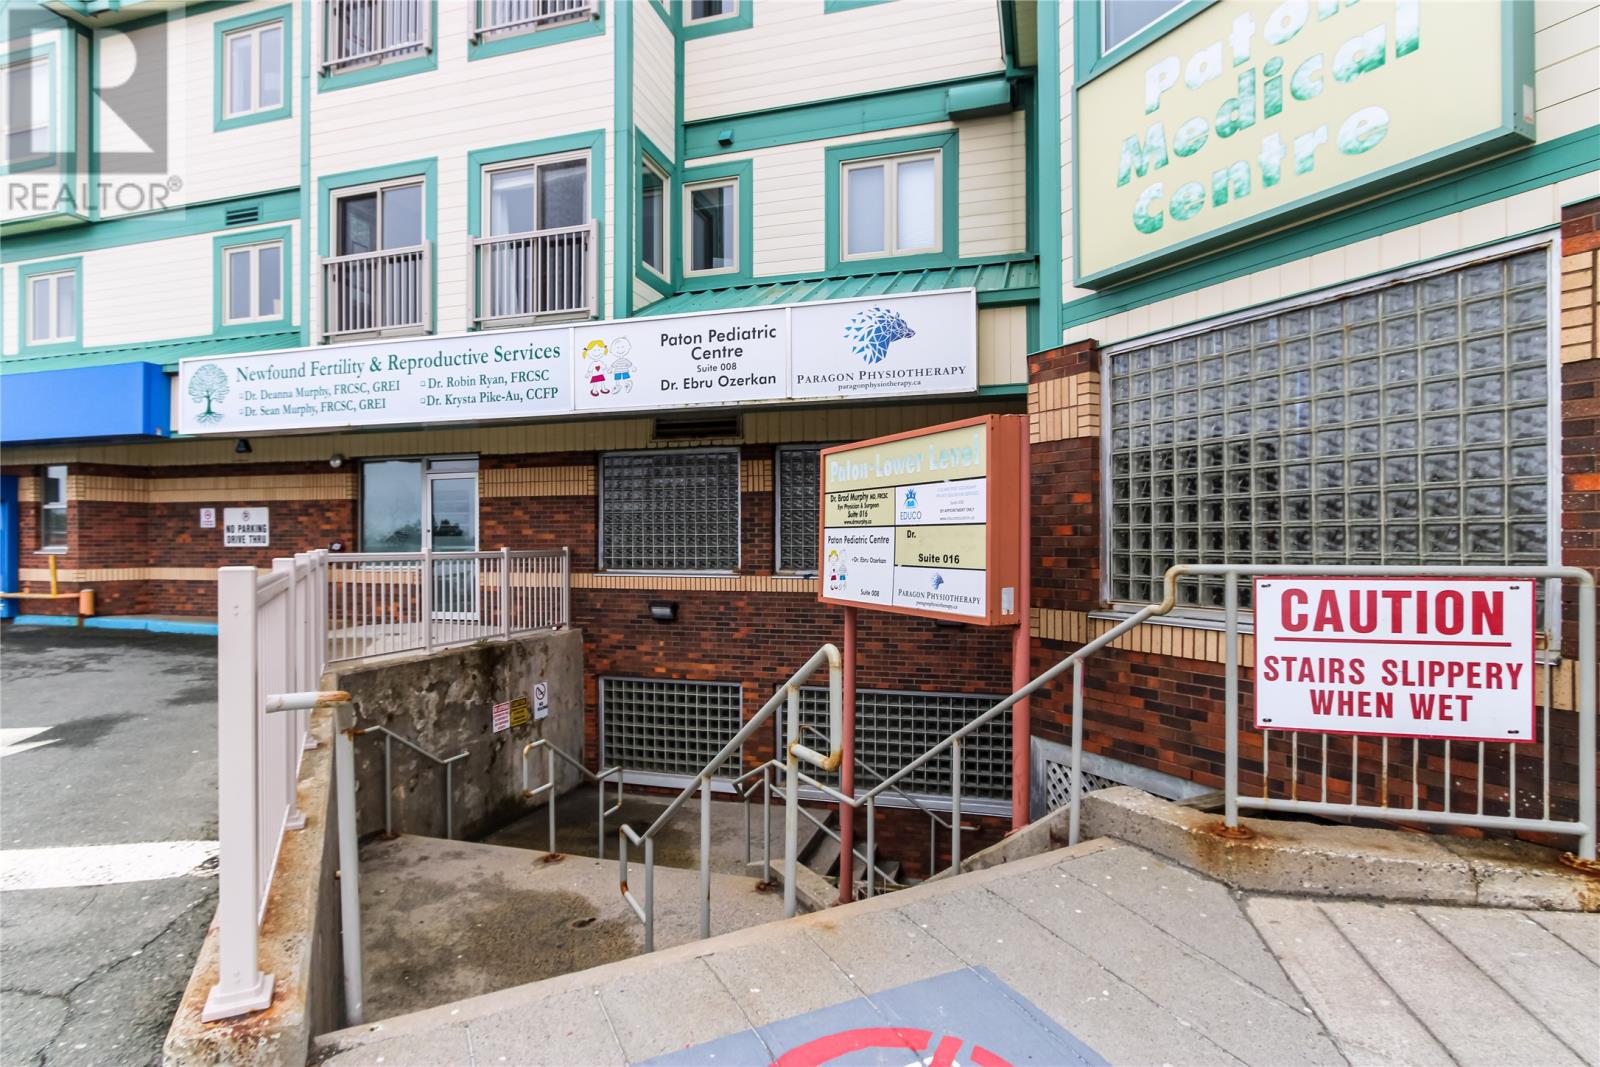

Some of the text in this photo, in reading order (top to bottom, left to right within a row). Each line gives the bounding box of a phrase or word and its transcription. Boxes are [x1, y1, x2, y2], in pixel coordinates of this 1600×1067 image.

[1117, 0, 1420, 188] Medical
[1133, 105, 1390, 234] Centre
[660, 324, 777, 347] Paton Pediatric
[236, 342, 561, 383] Newfound Fertility & Reproductive Services
[691, 346, 743, 361] Centre
[697, 362, 737, 373] Suite 008
[797, 366, 967, 385] PARAGON PHYSIOTHERAPY
[428, 369, 550, 389] Dr. Robin Ryan, FRCSC
[660, 373, 776, 391] Dr. Ebru Ozerkan
[838, 380, 922, 391] paragonphysiotherapy.ca
[245, 380, 400, 401] Dr. Deanna Murphy, FRCSC, GREI
[427, 387, 559, 408] Dr. Krysta Pike-Au, CCFP
[245, 398, 386, 417] Dr. Sean Murphy, FRCSC, GREI
[928, 432, 980, 471] Level
[837, 493, 849, 502] Brad
[850, 492, 868, 501] Murphy
[847, 510, 868, 518] Suite 016
[900, 511, 922, 520] EDUCO
[226, 524, 267, 533] NO PARKING
[906, 529, 917, 538] Dr.
[227, 535, 267, 544] DRIVE THRU
[828, 534, 890, 544] Paton Pediatric Centre
[918, 553, 960, 564] Suite 016
[898, 588, 981, 605] PARAGON PHYSIOTHERAPY
[1280, 588, 1504, 636] CAUTION
[1263, 655, 1524, 690] STAIRS SLIPPERY
[1310, 689, 1473, 722] WHEN WET
